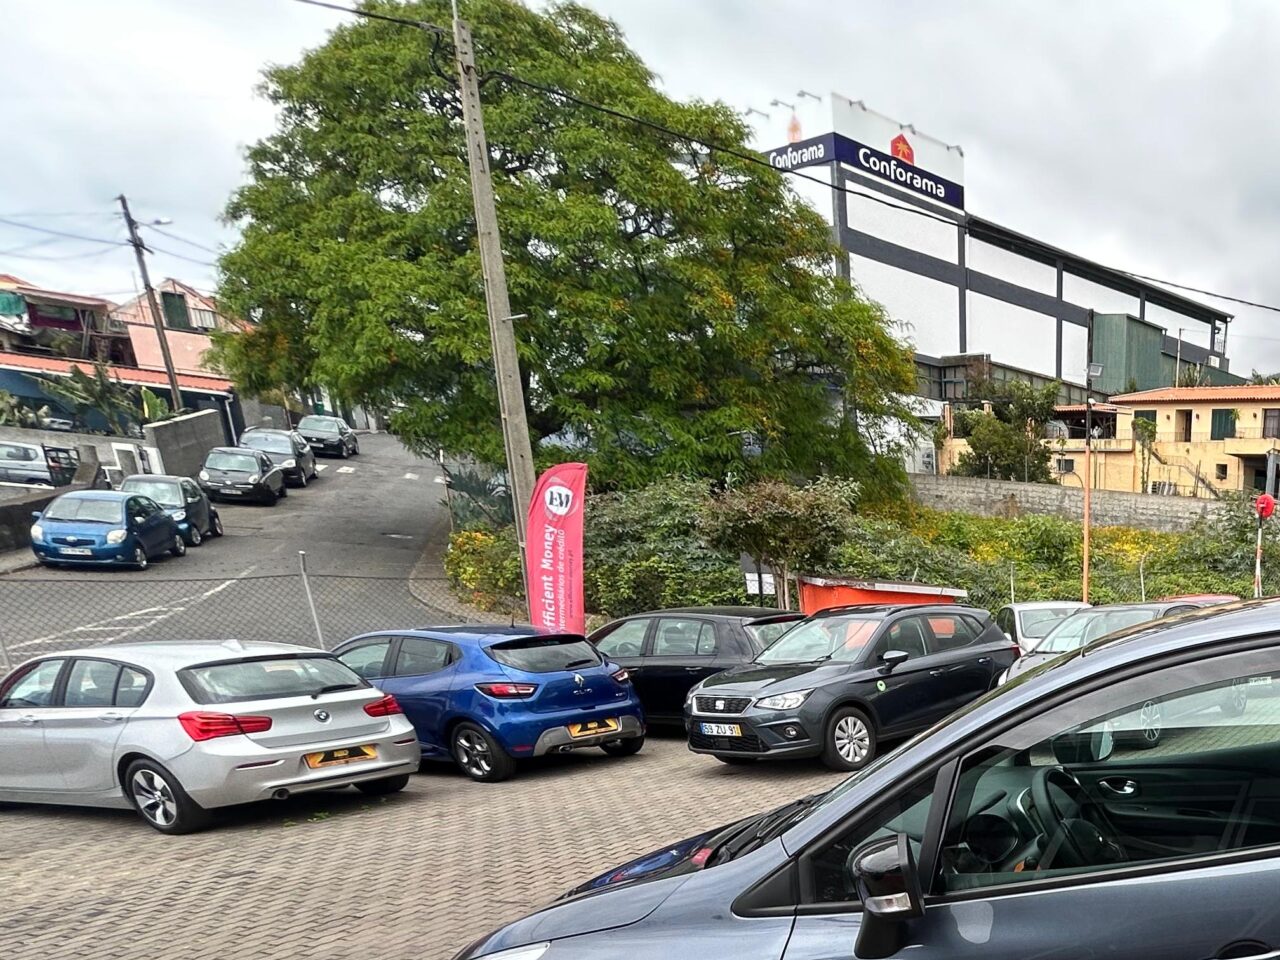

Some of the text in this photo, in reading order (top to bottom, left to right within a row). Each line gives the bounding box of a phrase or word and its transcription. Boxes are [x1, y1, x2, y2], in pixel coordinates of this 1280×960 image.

[769, 143, 824, 168] Conforama
[858, 147, 945, 198] Conforama
[540, 523, 557, 627] fficient Money
[715, 724, 727, 735] ZU
